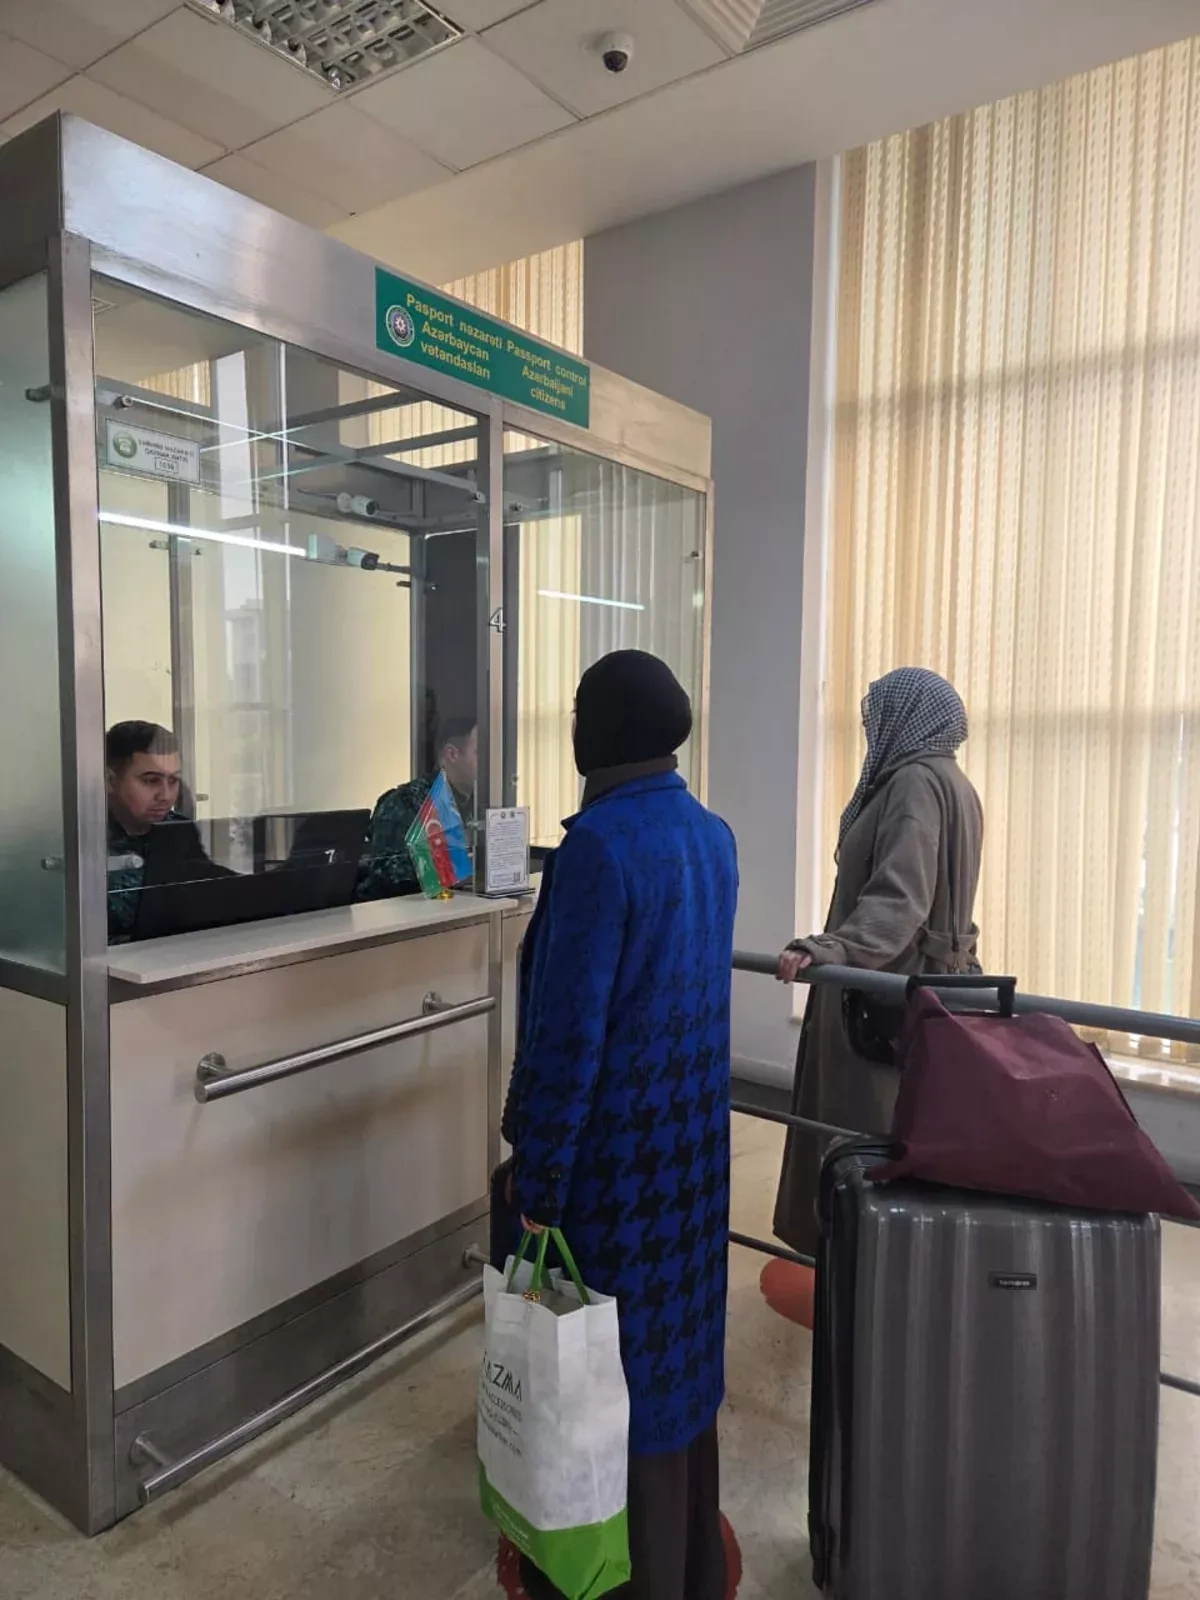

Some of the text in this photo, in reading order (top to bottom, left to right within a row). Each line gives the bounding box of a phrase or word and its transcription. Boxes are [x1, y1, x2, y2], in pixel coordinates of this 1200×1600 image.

[406, 293, 454, 328] Pasport
[507, 339, 587, 388] Passport control
[530, 387, 566, 411] citizens
[488, 607, 507, 633] 4
